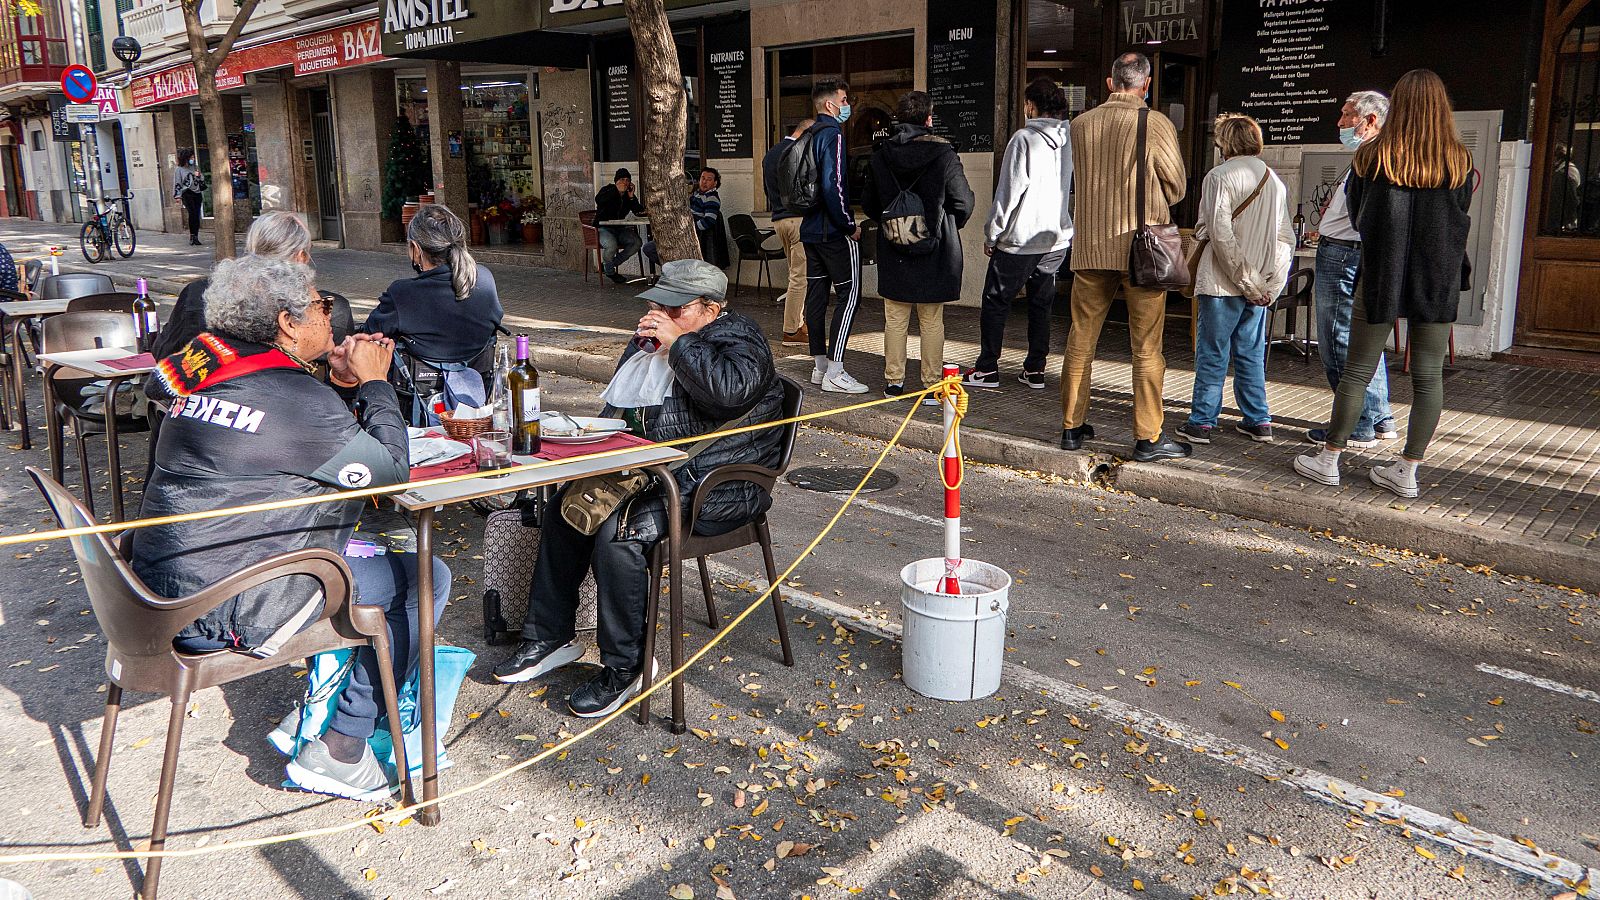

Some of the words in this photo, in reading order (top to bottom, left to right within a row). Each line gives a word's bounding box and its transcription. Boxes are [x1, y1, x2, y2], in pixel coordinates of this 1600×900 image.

[384, 0, 468, 34] AMSTEL
[1124, 6, 1198, 44] VENECIA
[296, 34, 334, 50] DROGUERIA
[405, 32, 426, 50] 100%
[426, 26, 454, 46] MALTA
[949, 28, 973, 41] MENU
[343, 26, 382, 60] BAZ
[298, 45, 337, 60] PERFUMERIA
[710, 51, 744, 63] ENTRANTES
[299, 57, 338, 72] JUGUETERIA
[608, 65, 628, 76] CARNES
[155, 70, 186, 99] BAZAR
[91, 88, 114, 100] AR
[53, 110, 61, 136] HOSTEL
